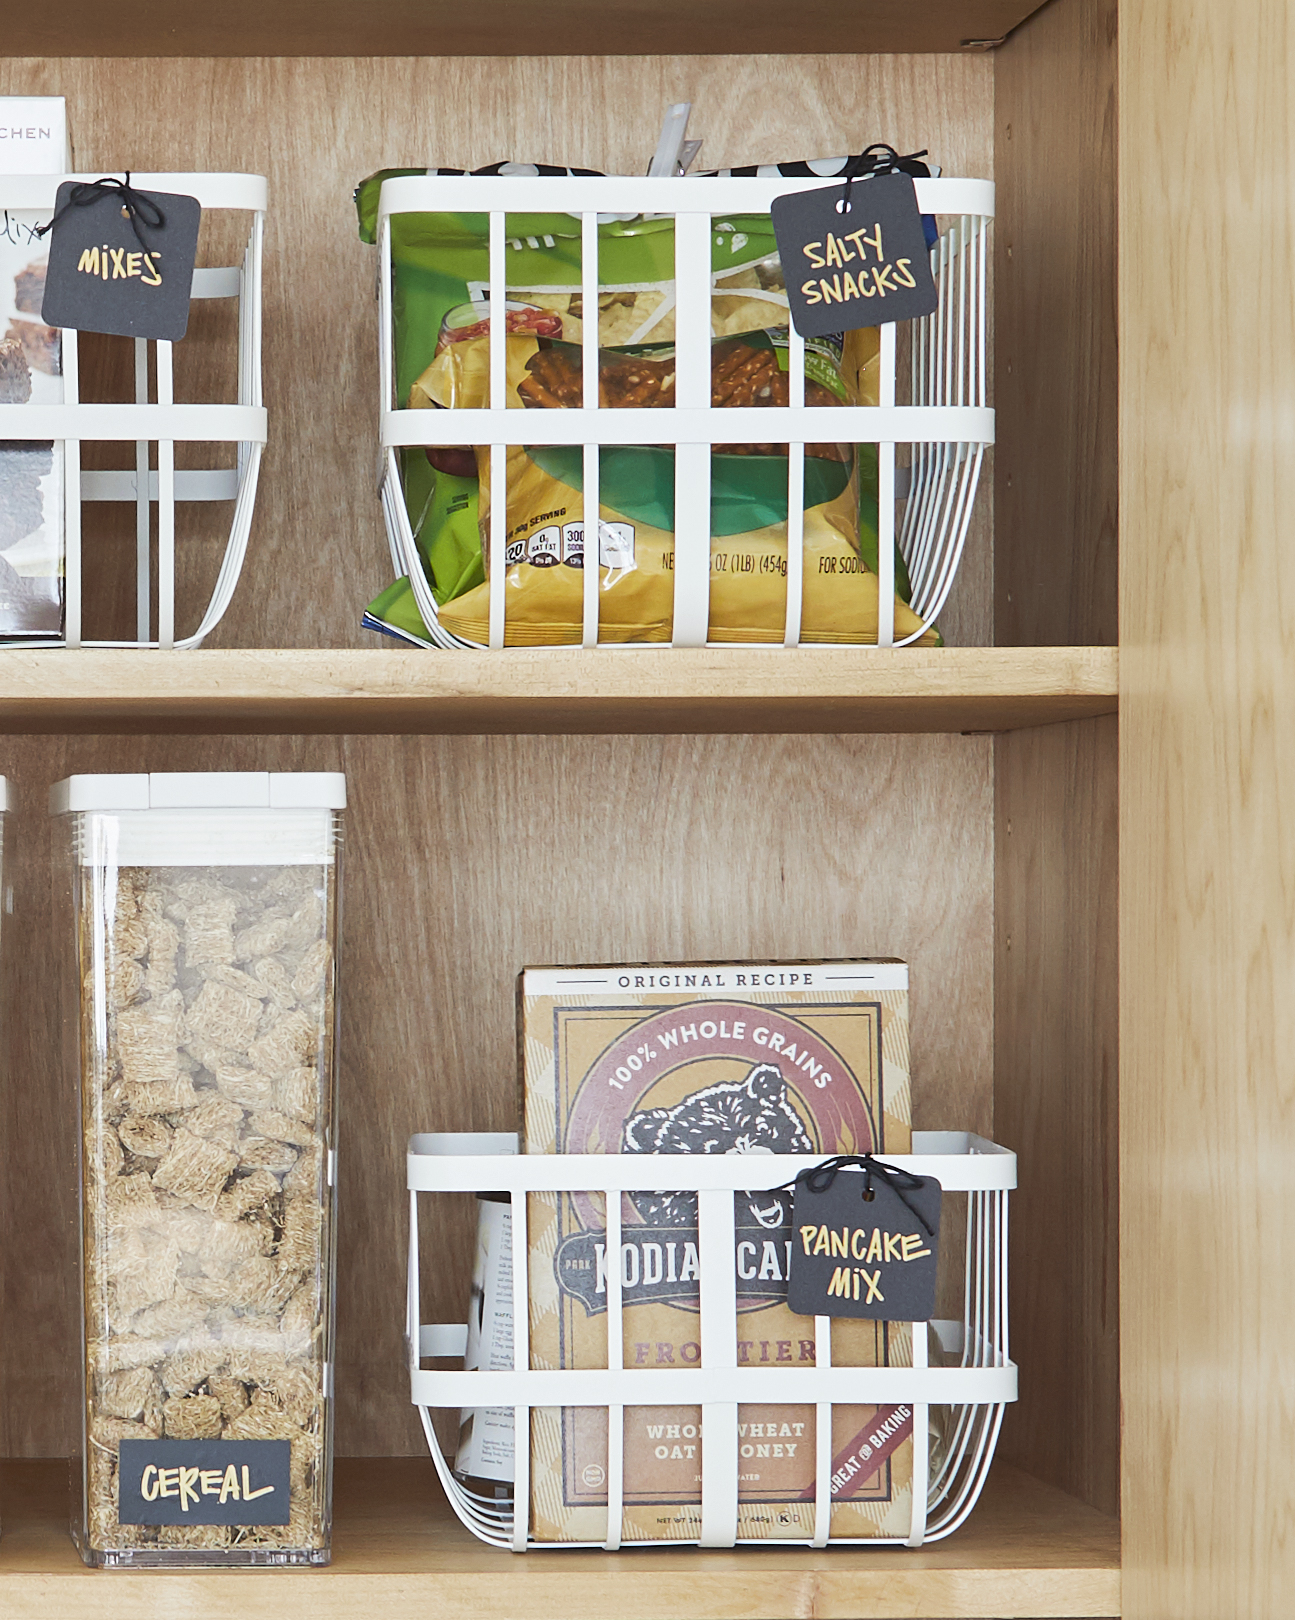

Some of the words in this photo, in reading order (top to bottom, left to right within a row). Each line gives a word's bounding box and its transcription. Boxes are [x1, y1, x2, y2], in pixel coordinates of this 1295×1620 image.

[803, 223, 885, 269] SALTY
[801, 258, 917, 305] SNACKS
[530, 508, 567, 527] SERVING
[715, 553, 727, 571] OZ
[818, 556, 837, 574] FOR
[617, 975, 726, 988] ORIGINAL
[736, 973, 814, 986] RECIPE
[607, 1042, 658, 1092] 100%
[657, 1019, 746, 1051] WHOLE
[751, 1025, 834, 1090] GRAINS
[799, 1224, 931, 1263] PANCAKE
[634, 1340, 816, 1364] FROTIER
[655, 1445, 696, 1459] OAT
[829, 1455, 863, 1495] GREAT
[868, 1404, 912, 1450] BAKING
[141, 1464, 275, 1512] CEREAL
